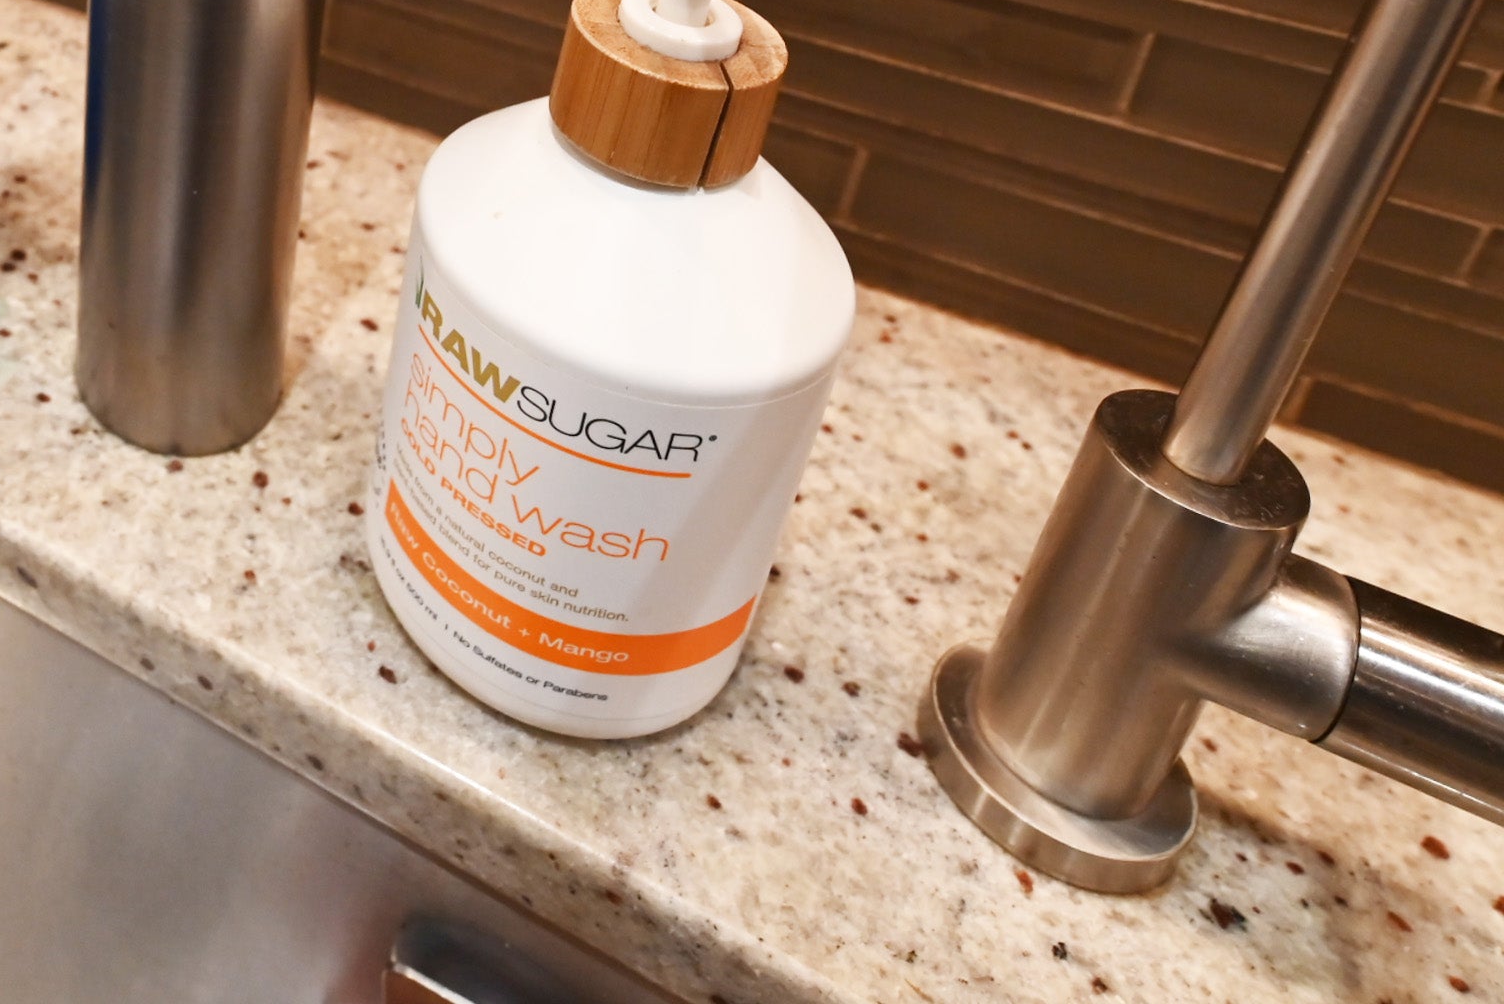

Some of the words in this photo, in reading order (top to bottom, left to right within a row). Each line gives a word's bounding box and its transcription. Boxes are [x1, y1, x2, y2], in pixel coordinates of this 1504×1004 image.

[405, 379, 498, 503] hand
[512, 494, 670, 562] wash
[411, 353, 540, 486] simply
[401, 418, 436, 475] COLD
[441, 477, 547, 557] PRESSED
[422, 551, 512, 630] Coconut
[538, 632, 630, 664] Mango
[439, 525, 470, 557] blend
[473, 552, 491, 572] for
[493, 570, 526, 593] pure
[530, 588, 559, 607] skin
[564, 602, 629, 623] nutrition.
[445, 512, 485, 552] natural
[489, 549, 546, 586] coconut
[550, 582, 579, 598] and
[453, 630, 471, 649] No
[473, 644, 523, 680] Sulfates
[526, 673, 540, 686] or
[542, 680, 609, 702] Parabens
